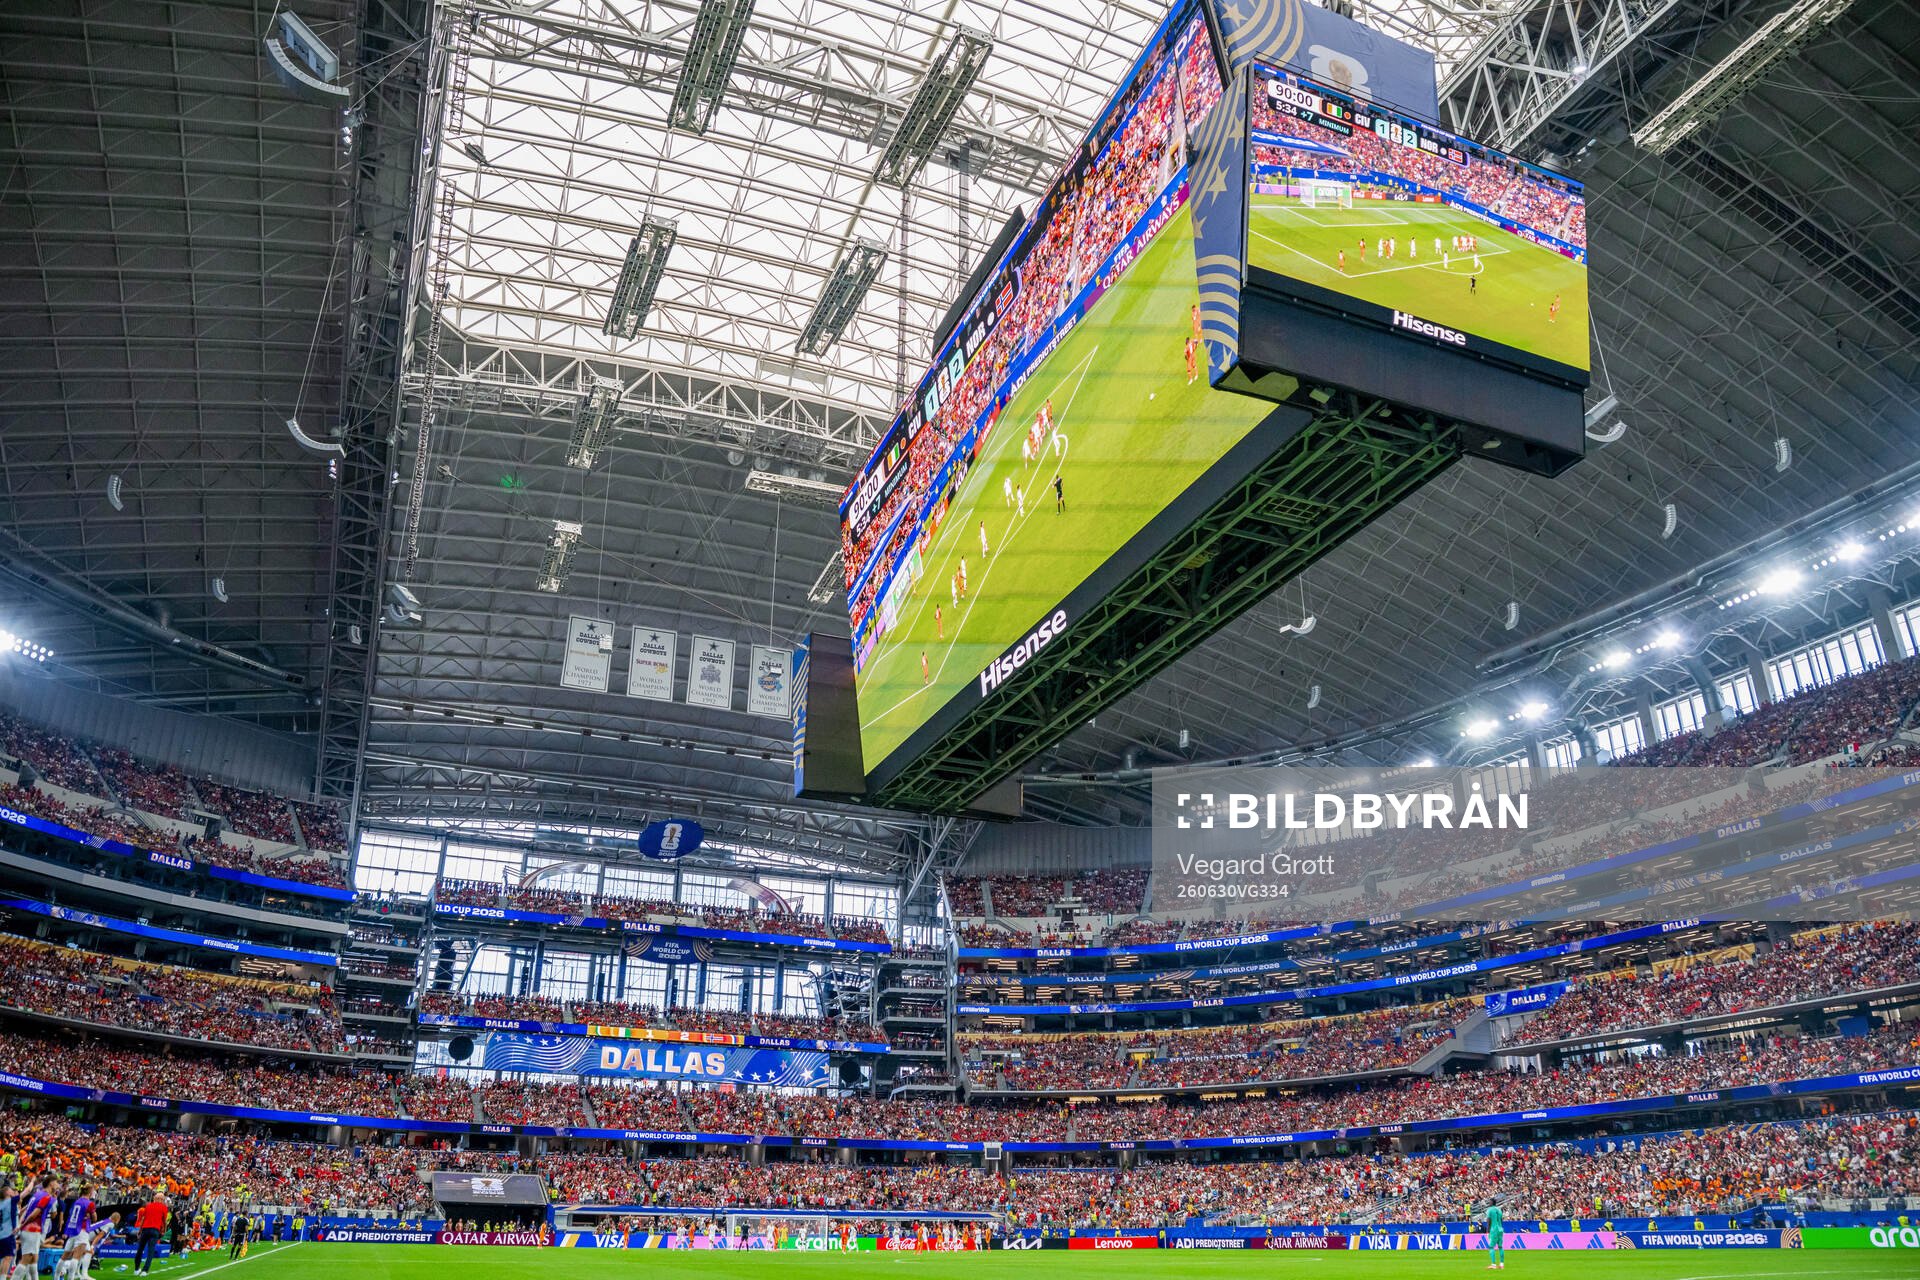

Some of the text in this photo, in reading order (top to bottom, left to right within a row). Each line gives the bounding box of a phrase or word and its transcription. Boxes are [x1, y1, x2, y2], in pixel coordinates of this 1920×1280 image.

[1276, 84, 1313, 107] 90:00
[1275, 101, 1314, 121] 5:34 +7
[1318, 118, 1350, 134] MINIMUM
[1355, 113, 1370, 127] CIV
[1408, 134, 1414, 145] 2
[1420, 138, 1438, 152] NOR
[1136, 197, 1180, 253] AIRWAYS
[1393, 309, 1466, 346] Hisense
[965, 322, 986, 358] NOR
[953, 359, 961, 378] 2
[1010, 373, 1027, 397] ADI
[908, 411, 922, 439] CIV
[854, 475, 878, 519] 90:00
[856, 510, 871, 538] 5:34
[642, 642, 665, 650] DALLAS
[702, 651, 724, 659] DALLAS
[980, 609, 1067, 697] Hisense
[0, 807, 27, 825] 026
[1717, 818, 1762, 839] DALLAS
[1779, 841, 1833, 861] DALLAS
[150, 852, 192, 870] DALLAS
[457, 905, 471, 915] CUP
[472, 907, 505, 918] 2026
[1369, 912, 1402, 925] DALLAS
[1661, 917, 1700, 932] DALLAS
[623, 921, 661, 932] DALLAS
[1175, 934, 1270, 951] FIFA WORLD CUP 2026
[1380, 940, 1418, 953] DALLAS
[652, 946, 676, 954] WORLD
[1037, 949, 1071, 957] DALLAS
[1209, 967, 1223, 975] FIFA
[1222, 965, 1245, 974] WORLD
[1258, 962, 1280, 970] 2026
[1411, 971, 1436, 982] WORLD
[1436, 969, 1451, 977] CUP
[1451, 963, 1477, 975] 2026
[1066, 975, 1106, 983] DALLAS
[1193, 999, 1224, 1007] DALLAS
[1511, 992, 1546, 1006] DALLAS
[485, 1019, 520, 1030] DALLAS
[645, 1029, 690, 1041] 1 2
[759, 1036, 790, 1047] DALLAS
[600, 1046, 725, 1076] DALLAS
[1858, 1074, 1878, 1083] FIFA
[1878, 1070, 1911, 1080] WORLD
[140, 1098, 168, 1109] DALLAS
[1688, 1092, 1719, 1103] DALLAS
[482, 1125, 511, 1133] DALLAS
[624, 1131, 640, 1139] FIFA
[640, 1132, 660, 1140] WORLD
[1379, 1126, 1403, 1134] DALLAS
[802, 1138, 827, 1146] DALLAS
[1110, 1142, 1135, 1150] DALLAS
[325, 1231, 433, 1243] ADI PREDICTSTREET
[441, 1231, 550, 1246] QATAR AIRWAYS
[593, 1234, 627, 1248] VISA
[1094, 1238, 1133, 1249] Lenovo
[1176, 1238, 1245, 1249] ADI PREDICTSTREET
[1294, 1236, 1328, 1249] AIRWAYS
[1366, 1235, 1391, 1249] VISA
[1415, 1235, 1443, 1249] VISA
[1642, 1233, 1766, 1246] FIFA WORLD CUP 2026
